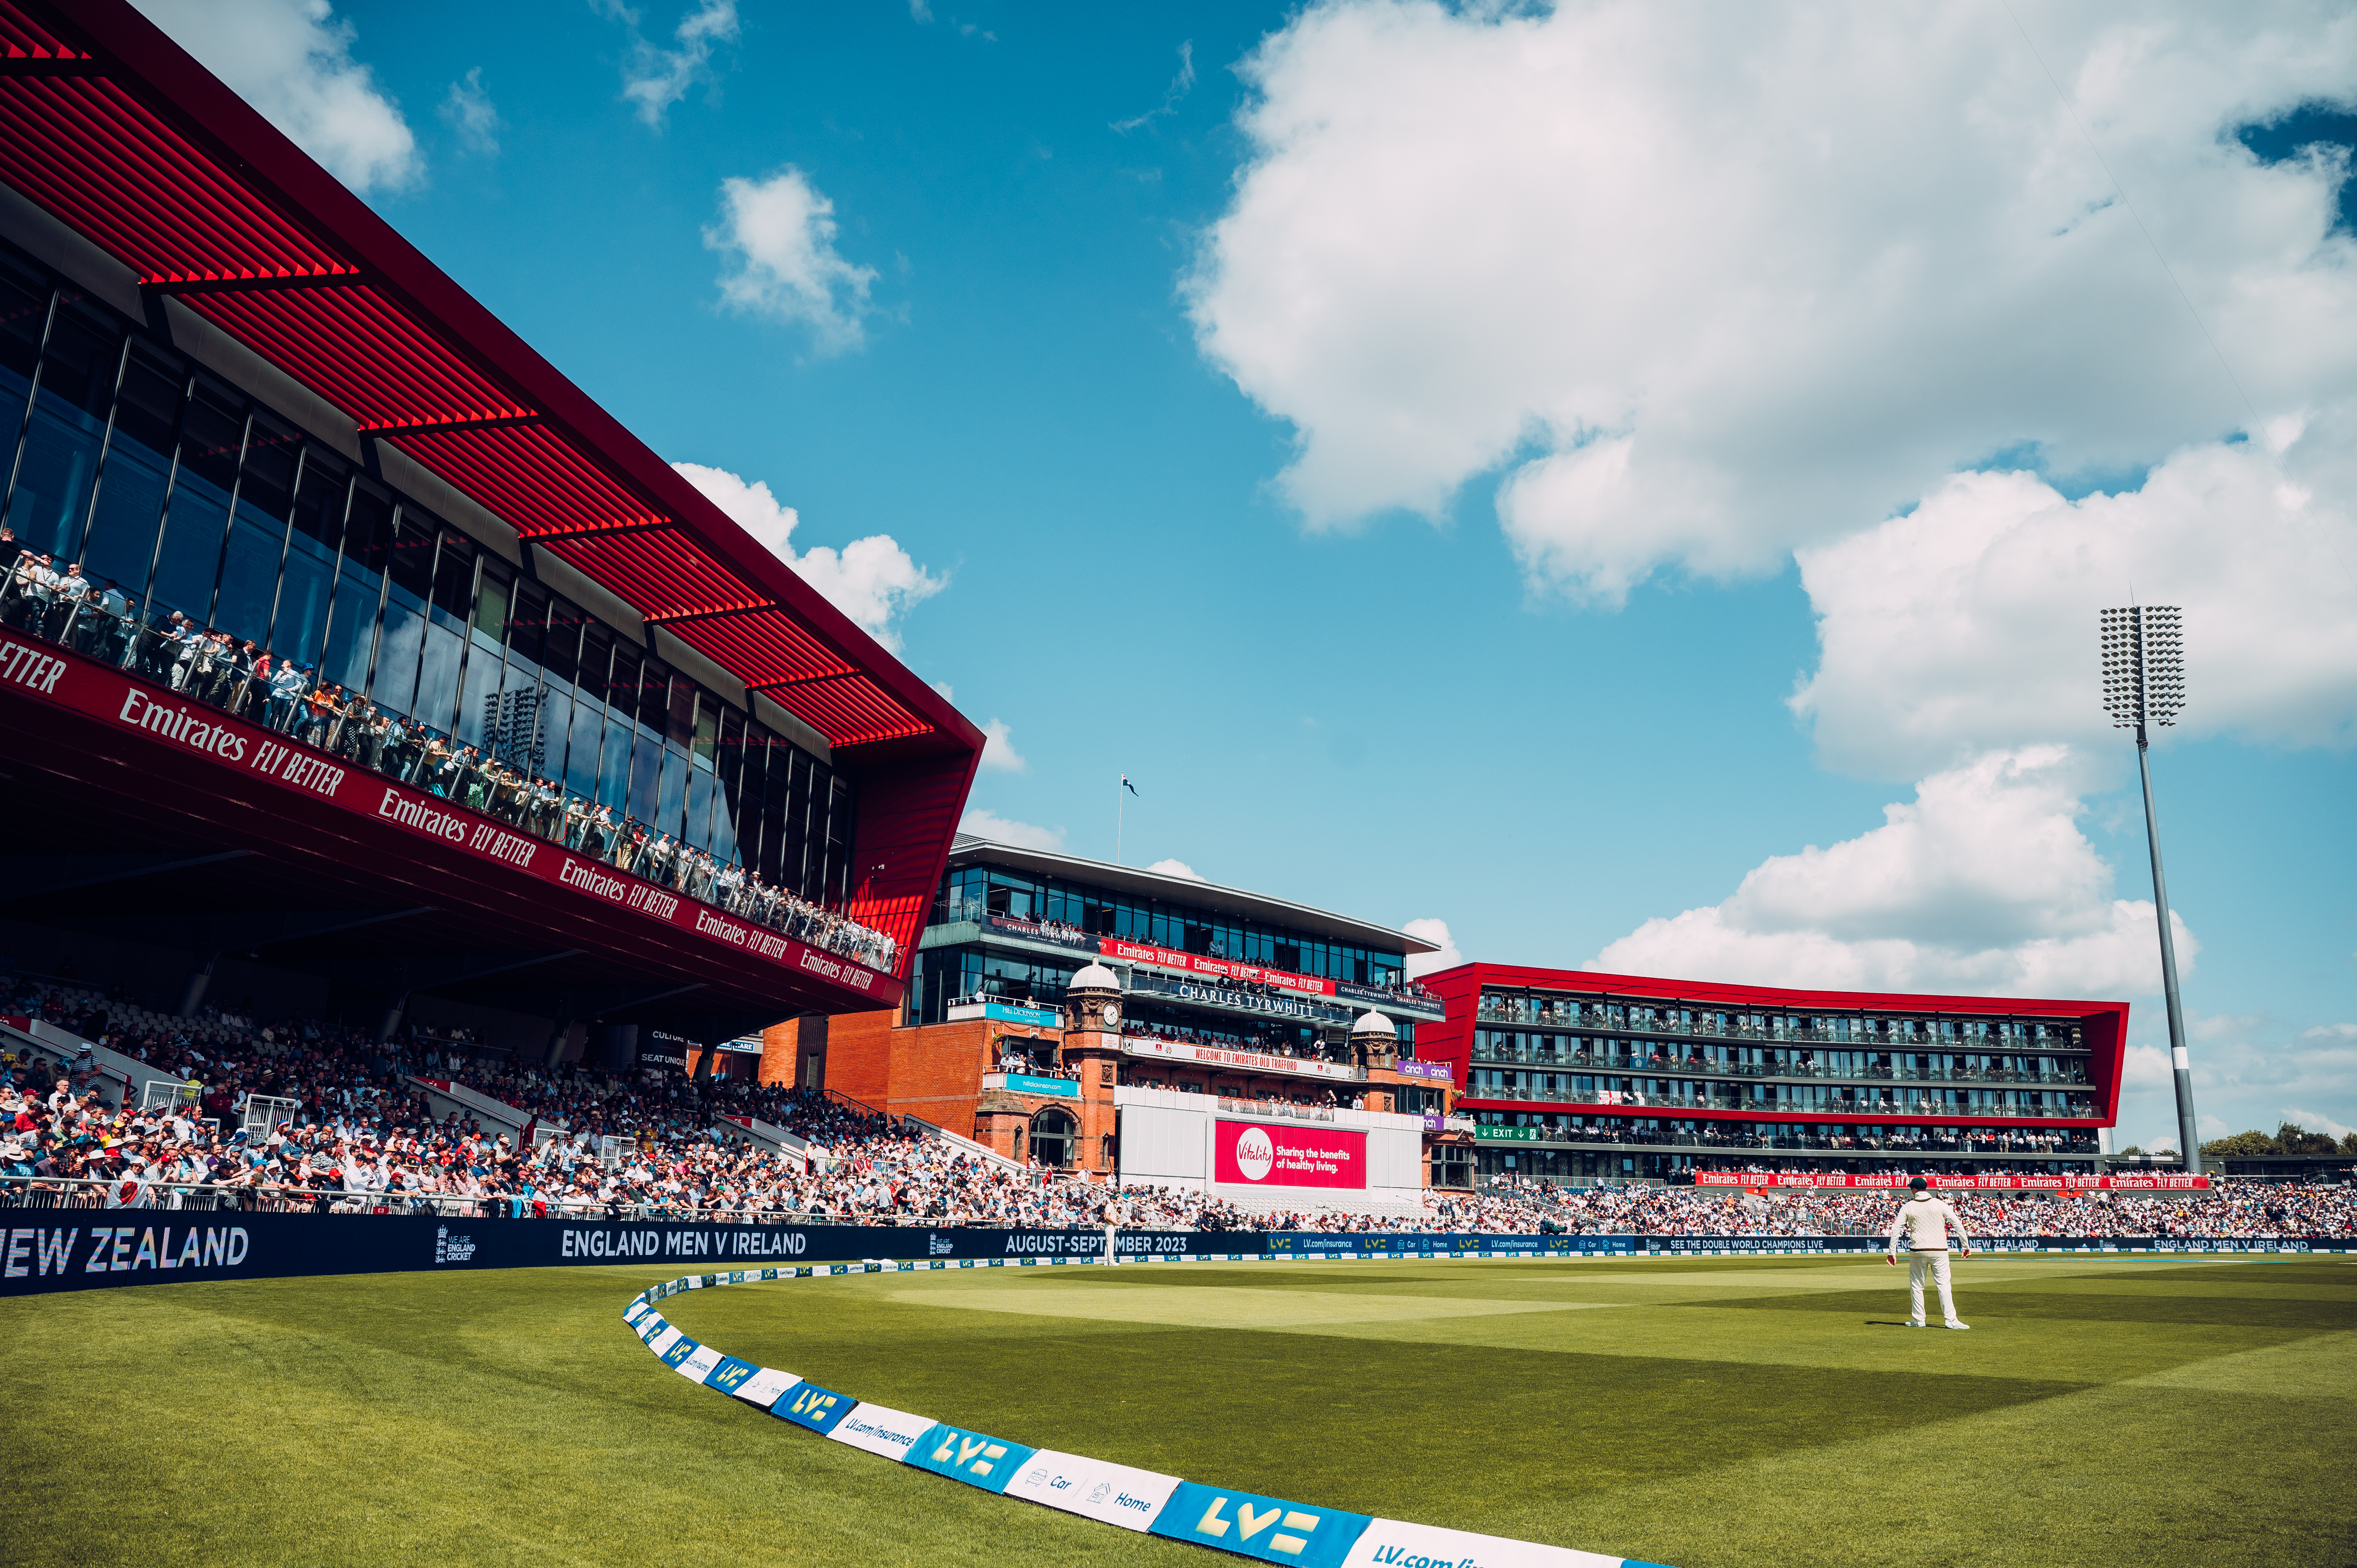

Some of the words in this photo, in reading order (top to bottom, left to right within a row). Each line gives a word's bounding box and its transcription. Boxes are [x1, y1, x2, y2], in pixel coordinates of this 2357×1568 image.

[0, 639, 66, 694] ETTER
[120, 688, 247, 760] Emirates
[251, 740, 289, 775] FLY
[281, 752, 345, 797] BETTER
[379, 788, 467, 842] Emirates
[469, 824, 496, 851] FLY
[490, 832, 536, 867] BETTER
[560, 857, 626, 901] Emirates
[627, 884, 648, 907] FLY
[643, 890, 678, 919] BETTER
[696, 910, 747, 945] Emirates
[746, 930, 763, 950] FLY
[759, 934, 787, 959] BETTER
[1007, 924, 1038, 935] CHARLES
[1117, 944, 1154, 960] Emirates
[1157, 951, 1167, 963] FLY
[1167, 953, 1186, 967] BETTER
[800, 949, 841, 979] Emirates
[840, 965, 853, 983] FLY
[850, 968, 873, 990] BETTER
[1194, 958, 1228, 974] Emirates
[1231, 965, 1240, 976] FLY
[1265, 971, 1296, 987] Emirates
[1298, 978, 1307, 988] FLY
[1307, 978, 1323, 992] BETTER
[1341, 987, 1363, 995] CHARLES
[1364, 991, 1389, 1000] TYRWHITT
[1180, 985, 1241, 1006] CHARLES
[1247, 995, 1314, 1017] TYRWHITT
[1397, 996, 1416, 1005] CHARLES
[1417, 1000, 1440, 1009] TYRWHITT
[1014, 1008, 1040, 1018] DICKINSON
[641, 1054, 664, 1062] SEAT
[665, 1057, 685, 1066] UNIQUE
[1196, 1048, 1221, 1061] WELCOME
[1223, 1052, 1230, 1063] TO
[1232, 1053, 1258, 1066] EMIRATES
[1260, 1057, 1269, 1067] OLD
[1271, 1058, 1297, 1071] TRAFFORD
[1405, 1062, 1423, 1075] cinch
[1431, 1065, 1448, 1078] cinch
[1023, 1080, 1062, 1090] hilldickinson.com
[1424, 1118, 1436, 1128] nch
[1493, 1129, 1513, 1138] EXIT
[1239, 1140, 1272, 1167] Vitality
[1276, 1146, 1304, 1159] Sharing
[1306, 1148, 1318, 1158] the
[1320, 1149, 1350, 1160] benefits
[1276, 1160, 1285, 1169] of
[1286, 1160, 1315, 1173] healthy
[1316, 1161, 1338, 1174] living.
[1703, 1174, 1738, 1184] Emirates
[1750, 1174, 1768, 1185] BETTER
[1777, 1175, 1814, 1185] Emirates
[1816, 1176, 1826, 1185] FLY
[1826, 1176, 1846, 1186] BETTER
[1855, 1176, 1892, 1186] Emirates
[1895, 1176, 1905, 1186] FLY
[1936, 1177, 1975, 1187] Emirates
[1978, 1178, 1989, 1187] FLY
[1990, 1178, 2011, 1187] BETTER
[2021, 1178, 2062, 1187] Emirates
[2066, 1178, 2074, 1188] FLY
[2078, 1178, 2099, 1187] BETTER
[2110, 1178, 2153, 1188] Emirates
[2157, 1178, 2167, 1187] FLY
[2169, 1178, 2192, 1187] BETTER
[85, 1227, 249, 1273] ZEALAND
[447, 1244, 475, 1252] ENGLAND
[562, 1230, 659, 1257] ENGLAND
[665, 1231, 709, 1256] MEN
[714, 1232, 728, 1255] V
[733, 1232, 806, 1254] IRELAND
[1005, 1235, 1152, 1252] AUGUST-SEPTMBER
[1156, 1237, 1186, 1252] 2023
[1303, 1239, 1352, 1250] LV.com/insurance
[1491, 1239, 1537, 1249] LV.com/insurance
[1670, 1240, 1684, 1249] SEE
[1686, 1240, 1701, 1249] THE
[1703, 1240, 1730, 1249] DOUBLE
[1731, 1240, 1760, 1249] WORLD
[1762, 1240, 1805, 1249] CHAMPIONS
[1807, 1240, 1823, 1248] LIVE
[1947, 1240, 1957, 1248] EN
[1969, 1240, 1991, 1248] NEW
[1994, 1239, 2039, 1248] ZEALAND
[2154, 1240, 2209, 1249] ENGLAND
[2213, 1240, 2238, 1249] MEN
[2243, 1241, 2250, 1249] V
[2254, 1241, 2308, 1250] IRELAND
[447, 1252, 472, 1261] CRICKET
[686, 1355, 711, 1373] LV.com/insurance
[769, 1386, 783, 1396] Home
[846, 1418, 914, 1447] LV.com/insurance
[1050, 1475, 1073, 1491] Car
[1114, 1492, 1151, 1512] Home
